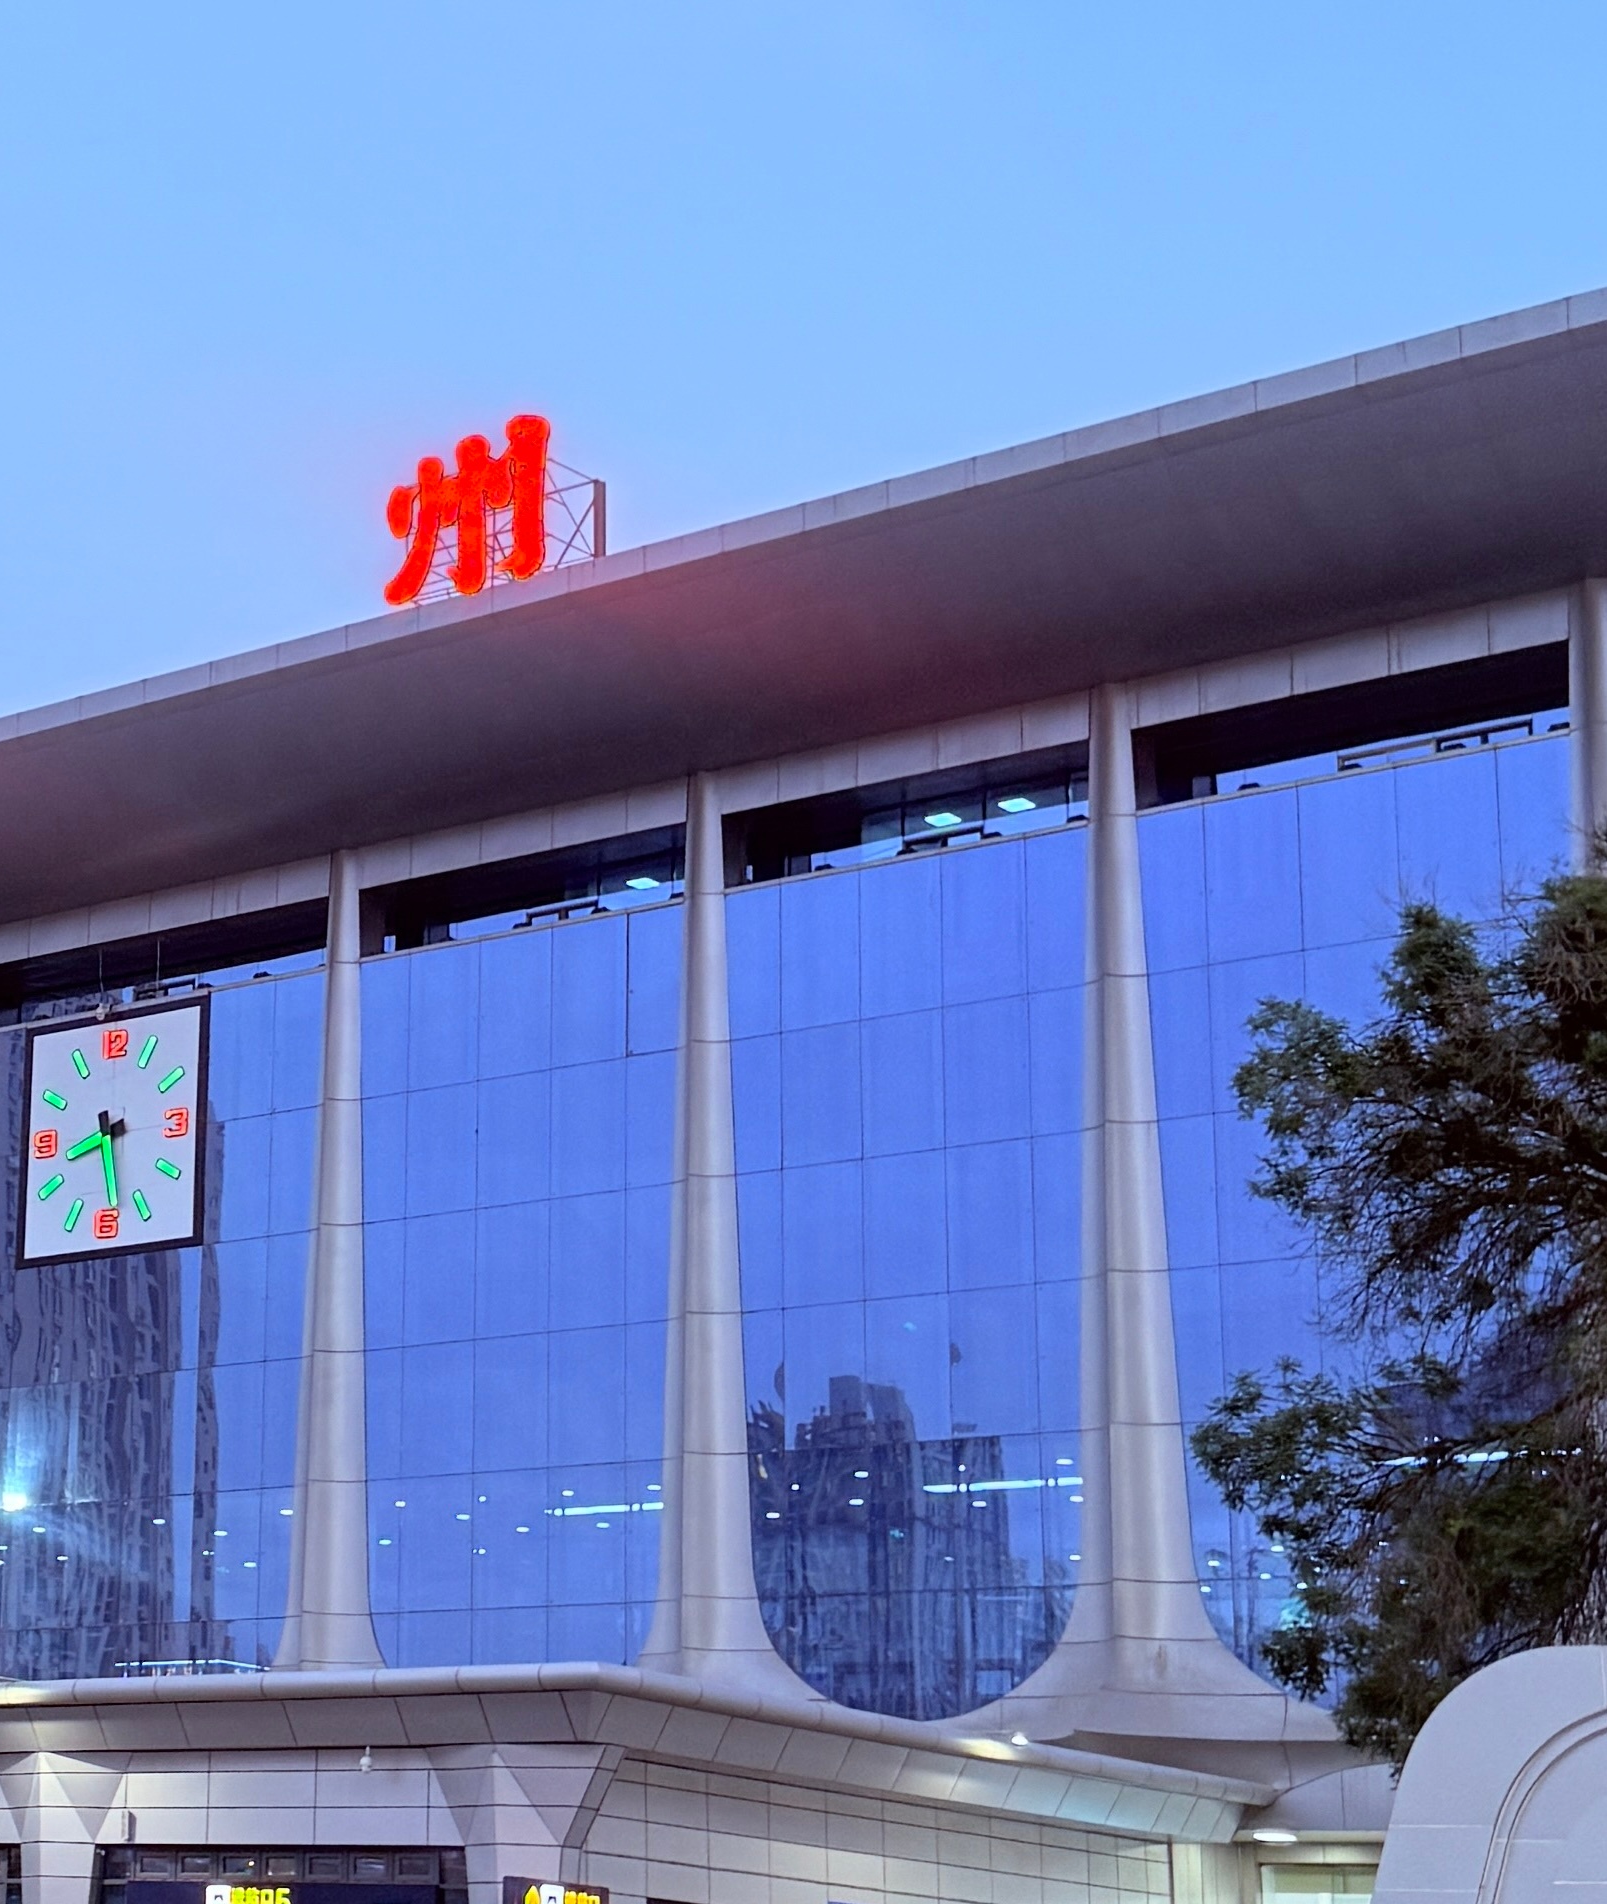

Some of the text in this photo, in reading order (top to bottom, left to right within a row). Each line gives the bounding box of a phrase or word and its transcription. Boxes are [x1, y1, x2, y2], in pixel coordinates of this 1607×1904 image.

[102, 1029, 129, 1060] 12
[163, 1107, 189, 1138] 3
[34, 1129, 58, 1159] 9
[94, 1208, 119, 1239] 6
